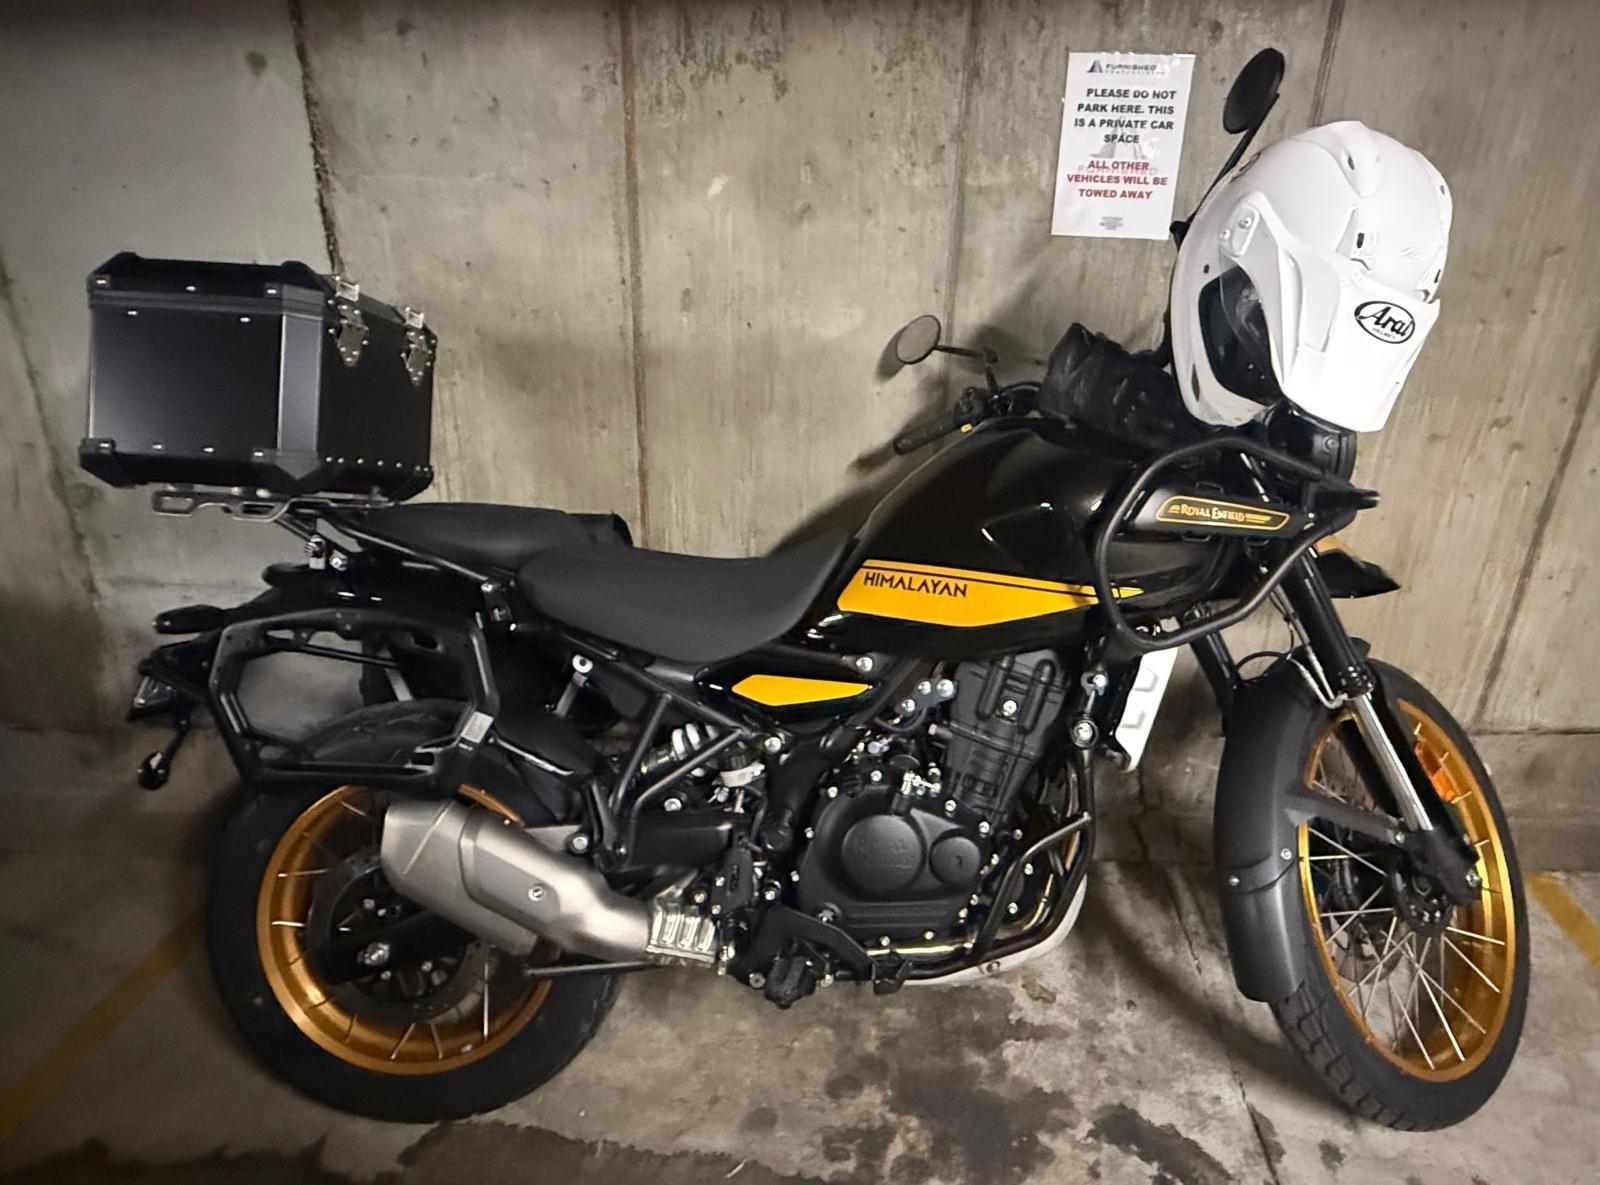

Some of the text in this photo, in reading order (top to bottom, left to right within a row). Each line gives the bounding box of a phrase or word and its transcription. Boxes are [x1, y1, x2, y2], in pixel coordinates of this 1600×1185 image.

[1086, 88, 1177, 99] PLEASE DO NOT
[1077, 103, 1174, 114] PARK HERE. THIS
[1074, 118, 1174, 130] IS A PRIVATE CAR
[1103, 134, 1140, 143] SPACE
[1087, 160, 1150, 170] ALL OTHER
[1067, 174, 1168, 186] VEHICLES WILL BE
[1078, 188, 1153, 199] TOWED AWAY
[1359, 306, 1413, 336] Arai
[1181, 503, 1246, 522] ROYAL ENFIELD
[863, 571, 968, 598] HIMALAYAN
